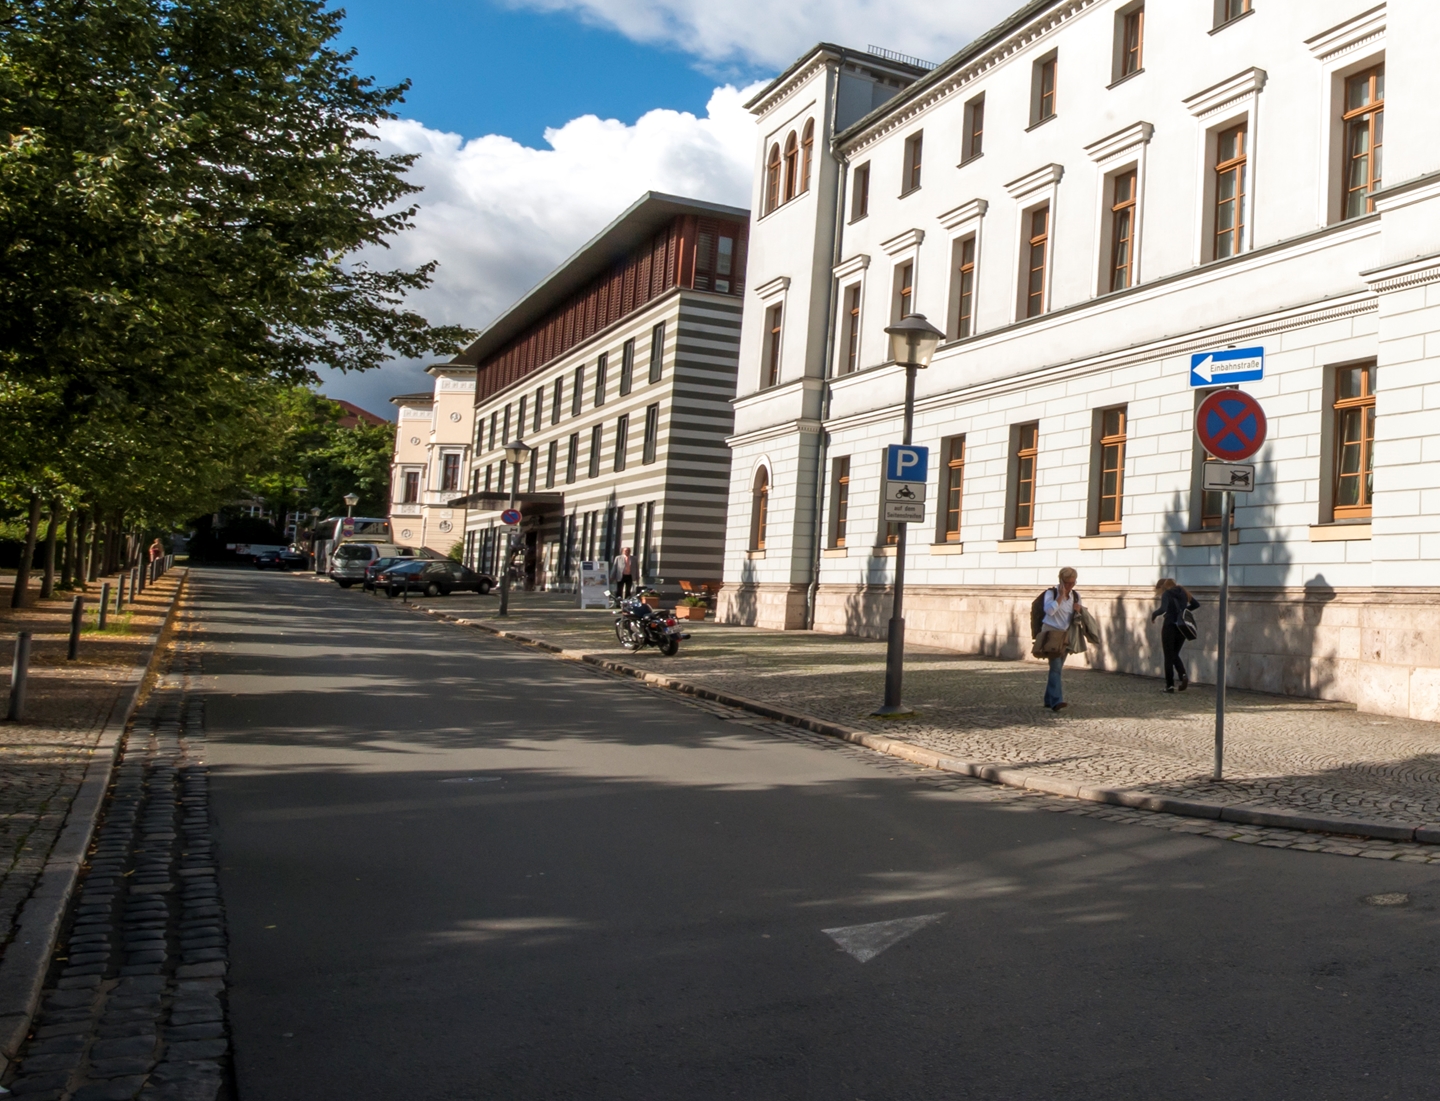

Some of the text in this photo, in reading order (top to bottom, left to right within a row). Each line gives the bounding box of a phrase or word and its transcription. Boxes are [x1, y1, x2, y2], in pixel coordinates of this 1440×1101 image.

[1210, 360, 1260, 373] Einbahnstraße
[896, 449, 919, 477] P
[887, 511, 922, 519] Seitenstreifen
